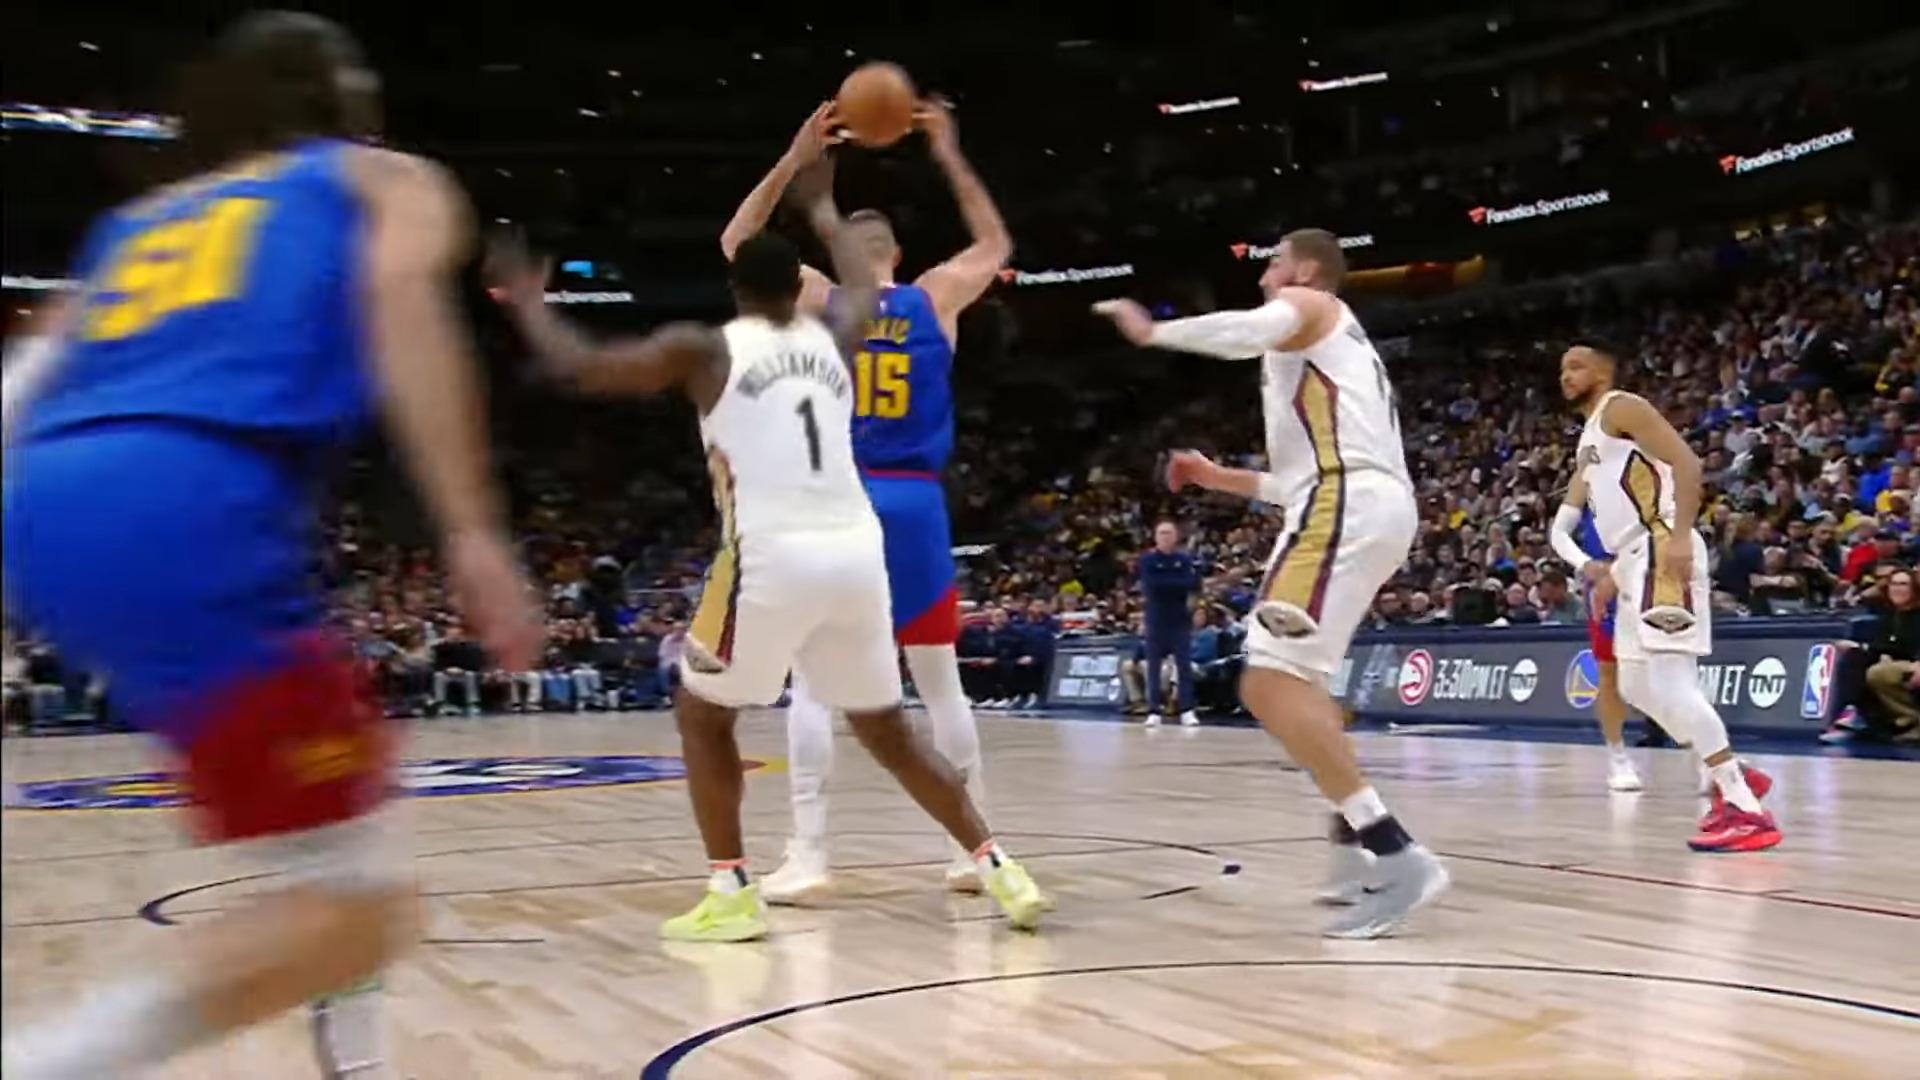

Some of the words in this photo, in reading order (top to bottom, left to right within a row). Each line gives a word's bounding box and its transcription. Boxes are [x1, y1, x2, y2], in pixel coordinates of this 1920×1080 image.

[1735, 148, 1783, 174] Fanatics
[1782, 127, 1854, 160] Sportsbook
[1536, 189, 1610, 216] Sportsbook
[855, 352, 912, 419] 15
[796, 395, 822, 472] 1
[1750, 674, 1787, 694] TNT
